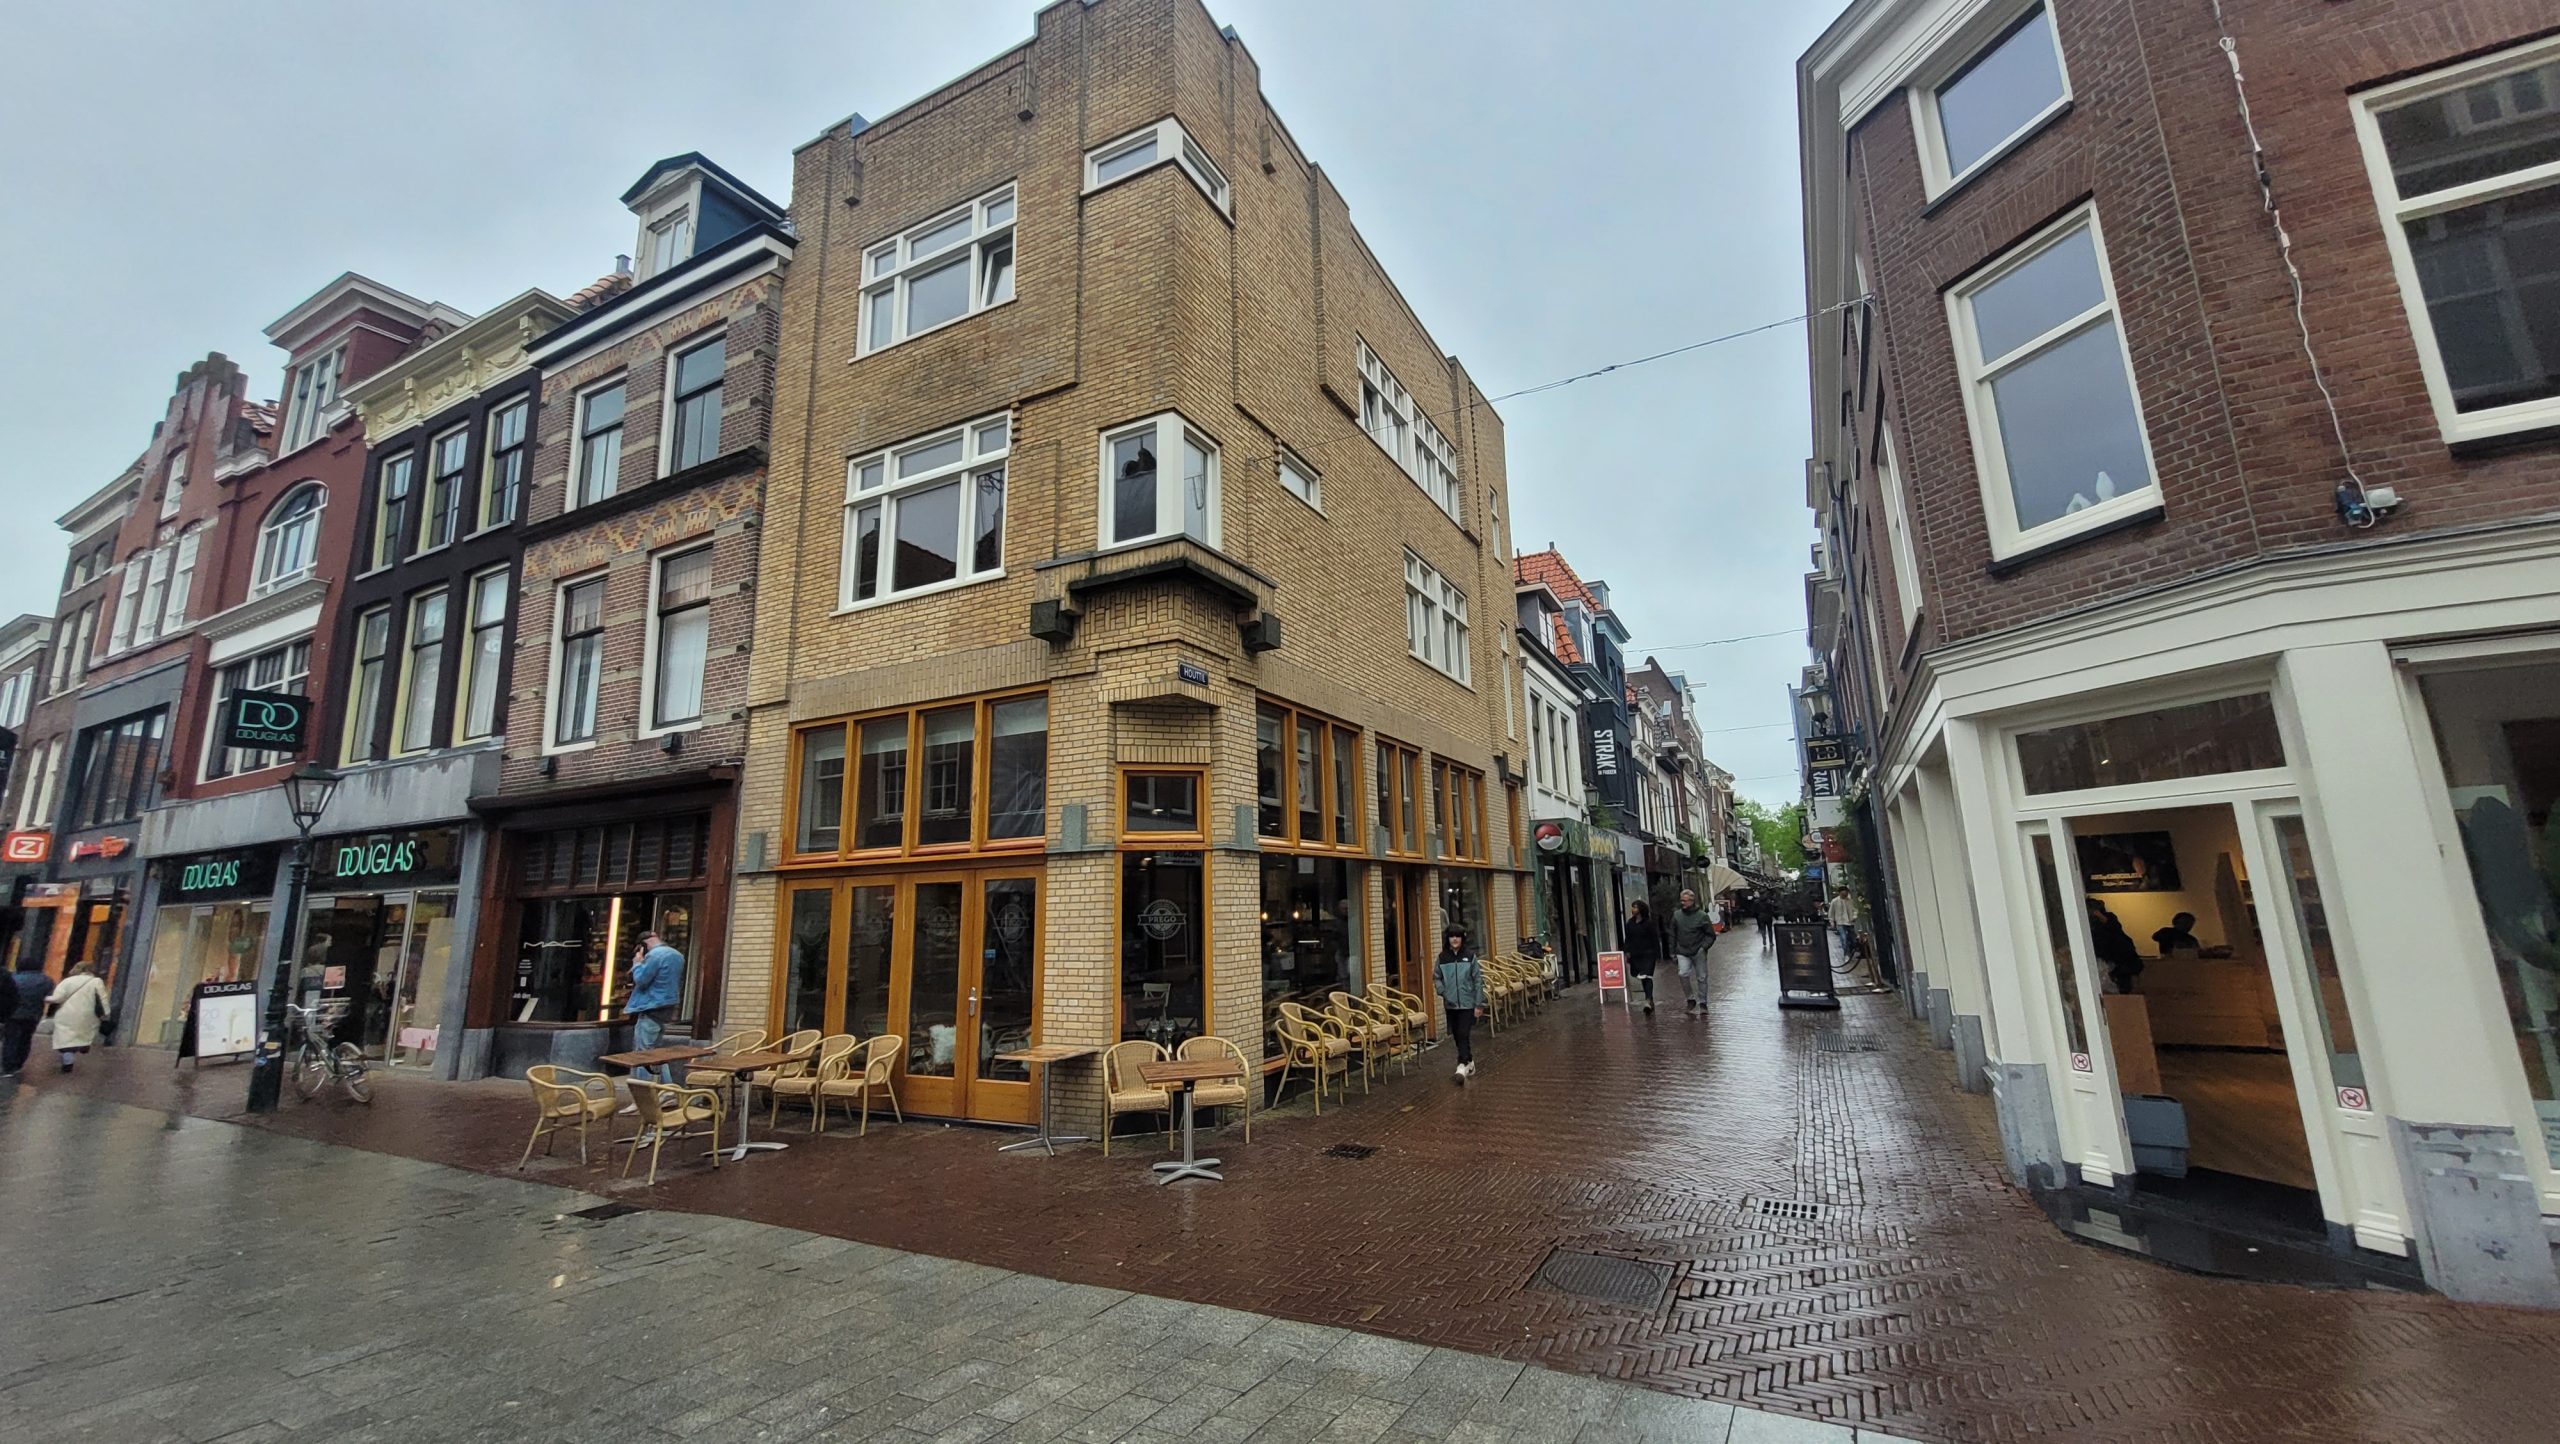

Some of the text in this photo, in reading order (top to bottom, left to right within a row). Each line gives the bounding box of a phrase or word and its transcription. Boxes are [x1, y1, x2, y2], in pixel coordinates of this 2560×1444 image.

[235, 729, 296, 742] DOUGLAS
[335, 840, 417, 877] DOUGLAS
[181, 859, 240, 891] DOUGLAS
[1148, 916, 1177, 924] PREGO
[203, 982, 253, 994] DOUGLAS
